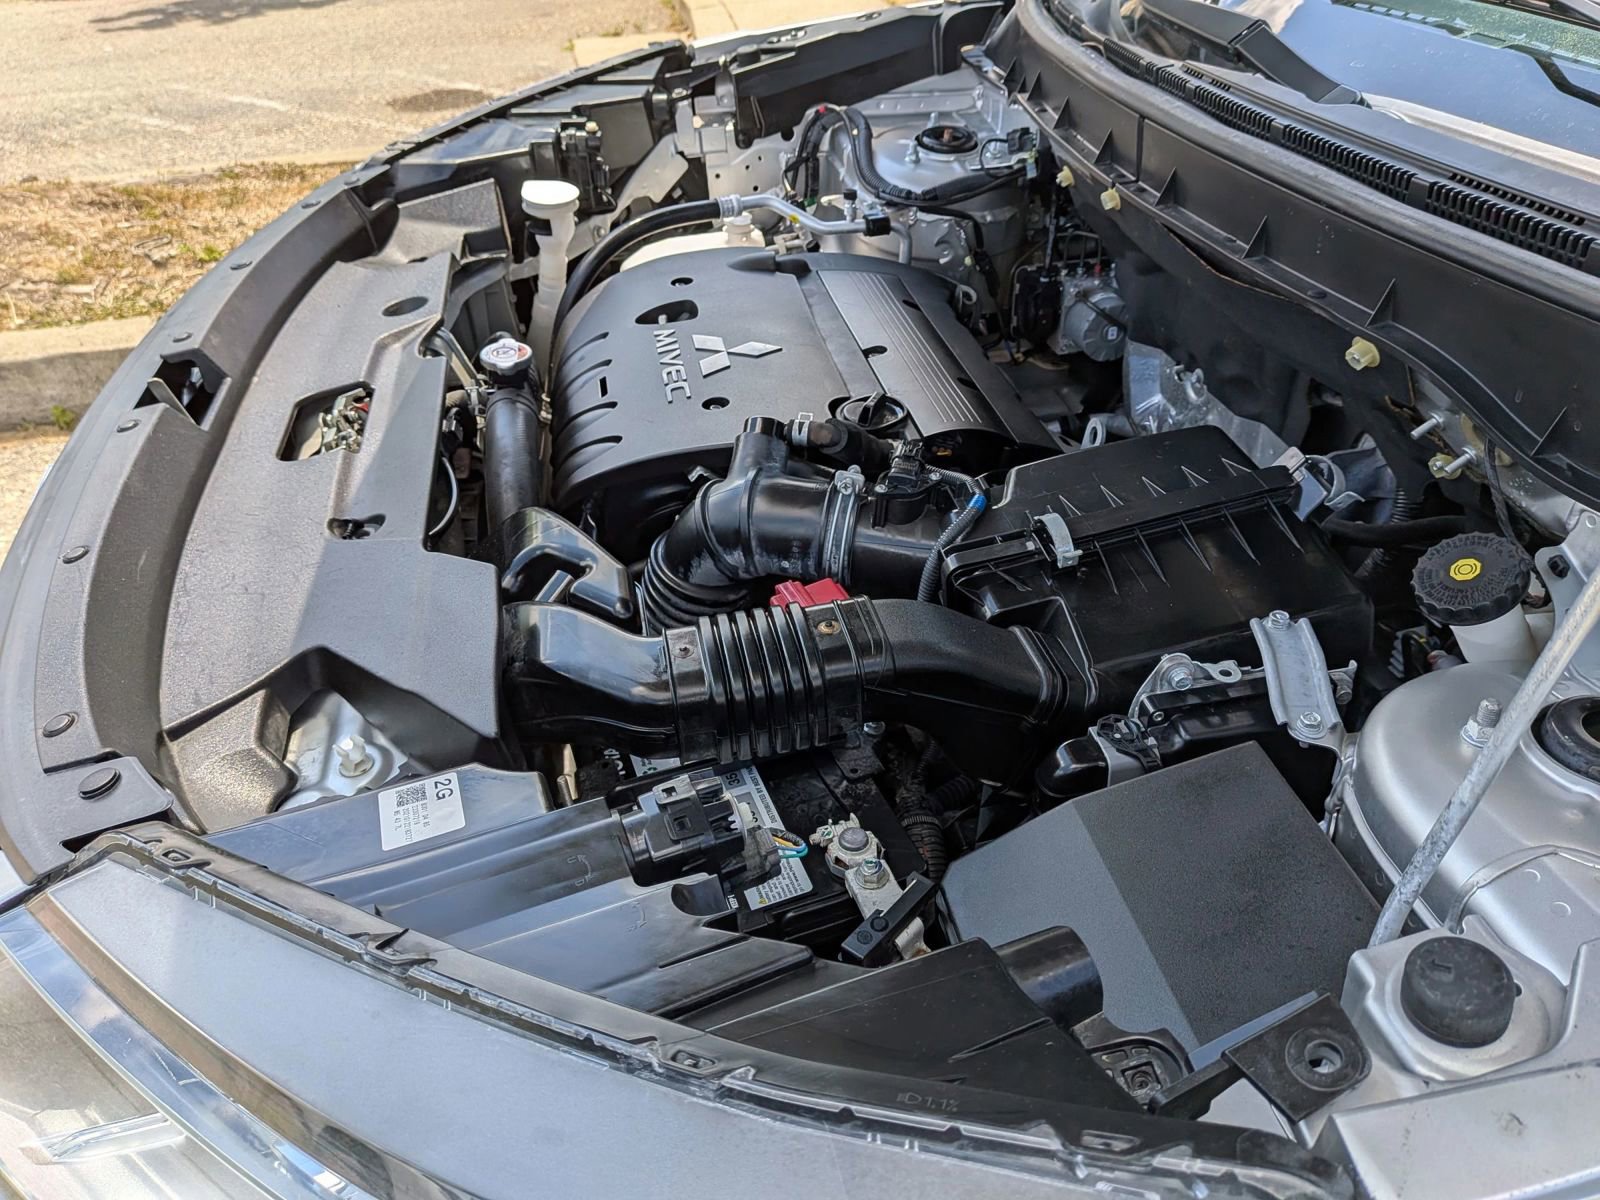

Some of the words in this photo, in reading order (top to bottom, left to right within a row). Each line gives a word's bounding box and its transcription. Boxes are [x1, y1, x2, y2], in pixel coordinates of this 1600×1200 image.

[653, 329, 691, 404] MIVEC
[725, 773, 740, 785] 35
[749, 775, 760, 787] BEST
[434, 778, 454, 801] 2G
[759, 793, 777, 823] DISTRIBUTED
[924, 1096, 960, 1112] 1.1%
